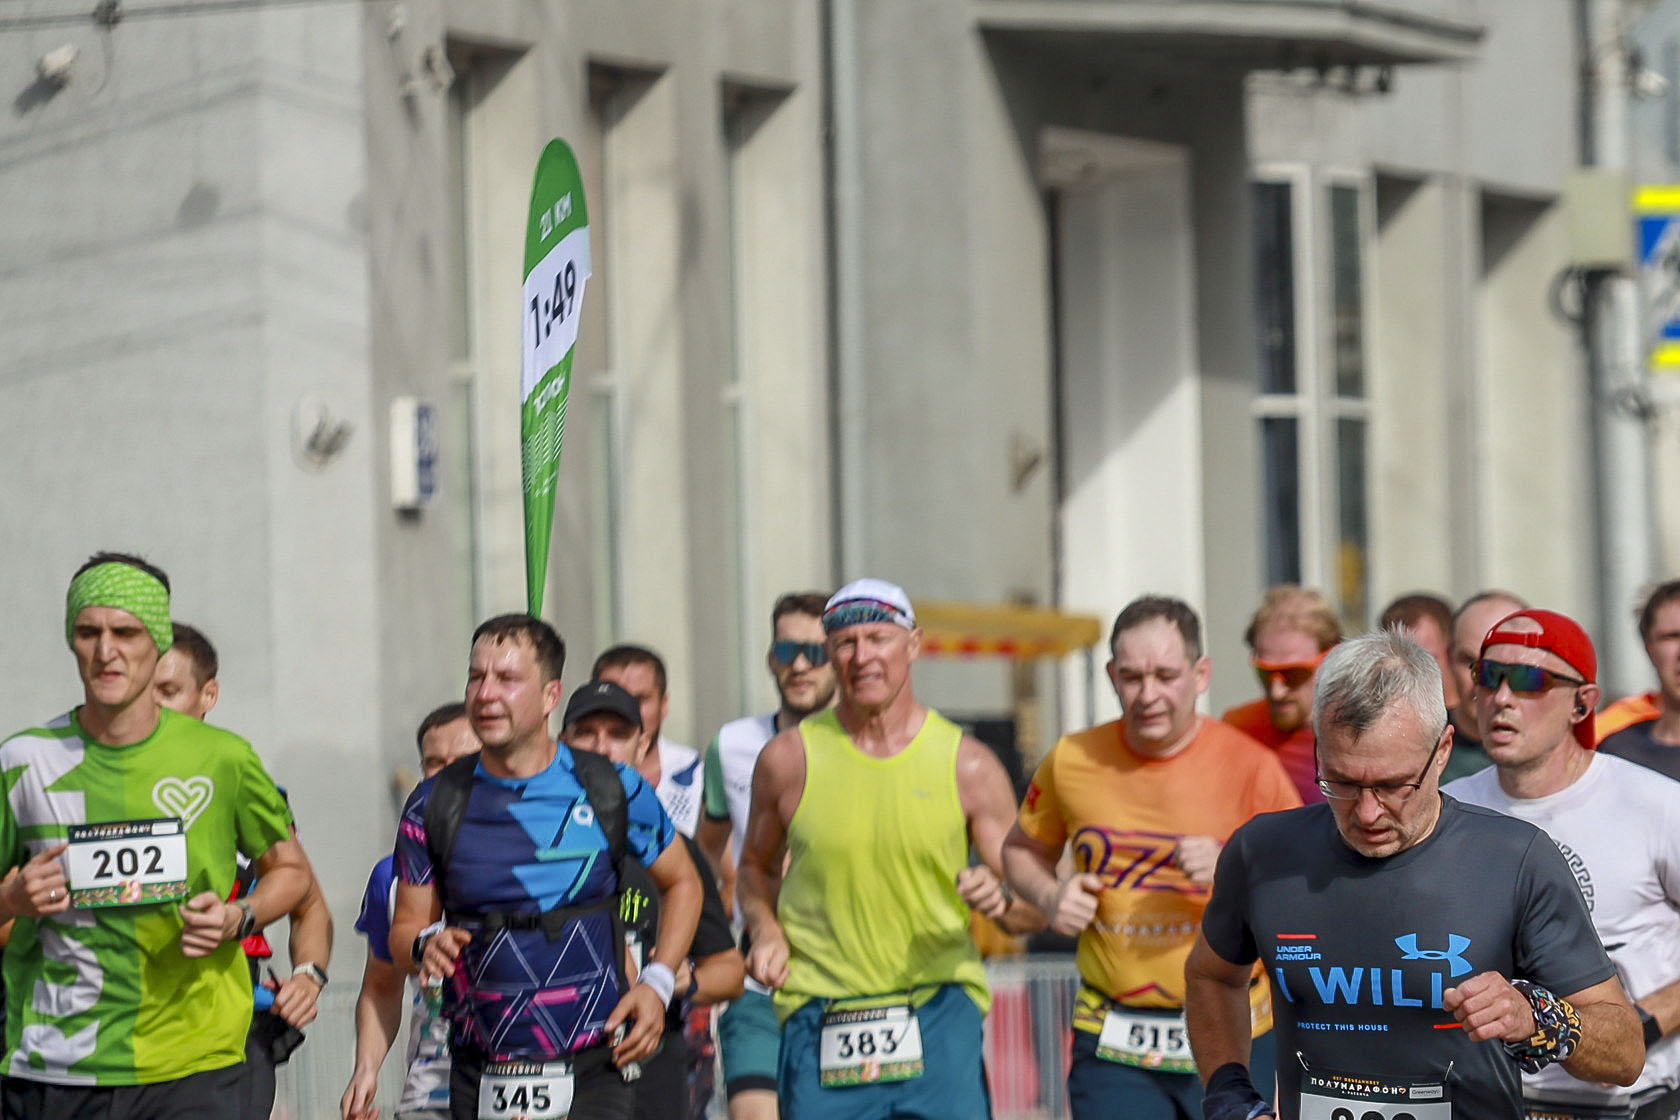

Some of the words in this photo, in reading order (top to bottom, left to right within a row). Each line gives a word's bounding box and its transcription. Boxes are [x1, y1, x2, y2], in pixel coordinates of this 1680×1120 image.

[530, 259, 576, 349] 1:49
[93, 845, 164, 879] 202
[1275, 953, 1322, 961] ARMOUR
[1276, 945, 1312, 953] UNDER
[1128, 1022, 1184, 1050] 515
[1297, 1021, 1331, 1031] PROTECT
[1335, 1023, 1354, 1031] THIS
[1358, 1023, 1389, 1031] HOUSE
[837, 1027, 898, 1059] 383
[492, 1083, 551, 1112] 345
[1311, 1077, 1398, 1095] ПОЛУМАРАФОН
